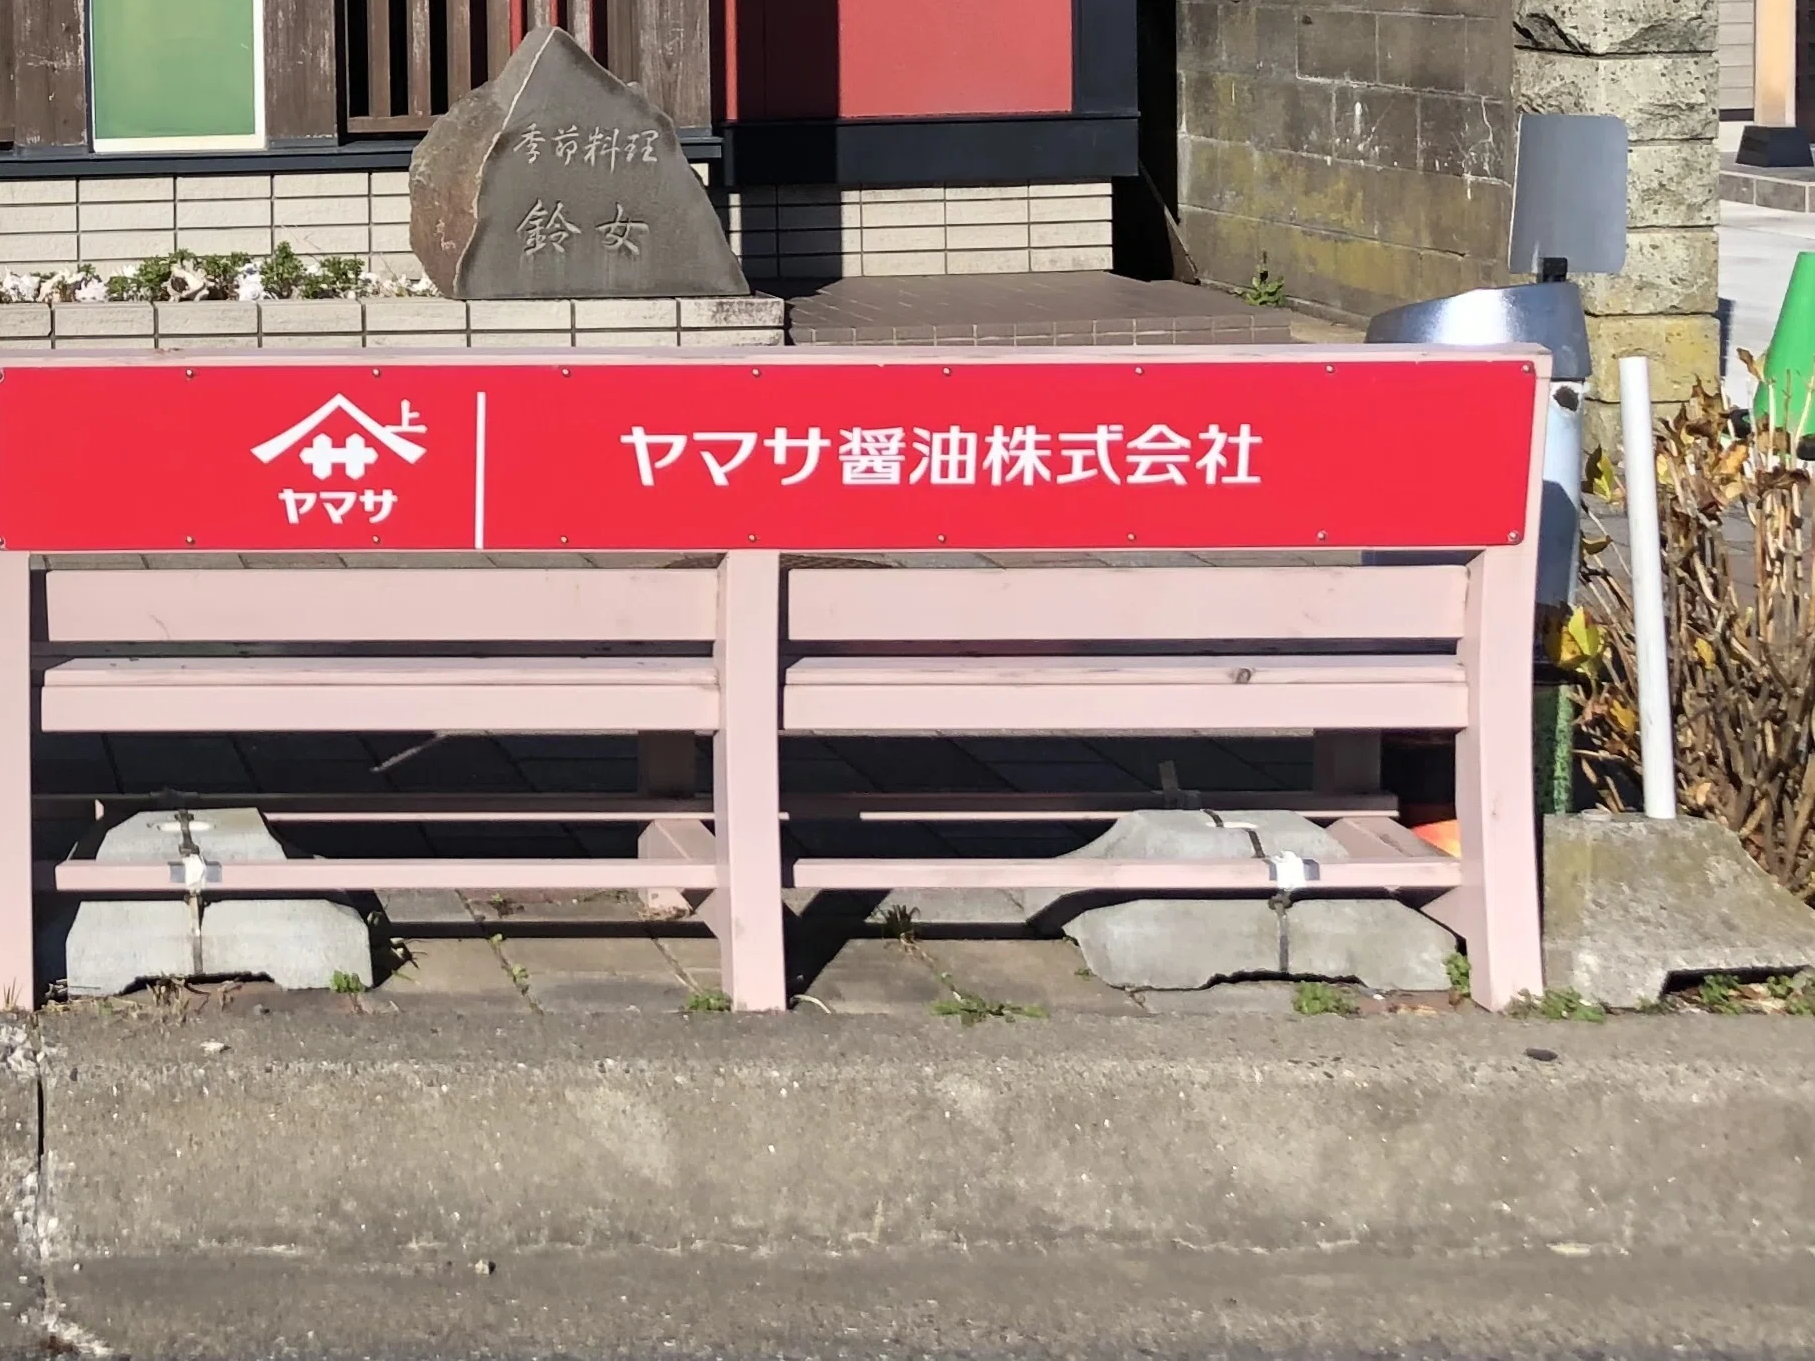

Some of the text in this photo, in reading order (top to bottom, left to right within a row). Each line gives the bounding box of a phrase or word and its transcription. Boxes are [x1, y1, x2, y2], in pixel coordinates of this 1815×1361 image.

[516, 199, 650, 255] 鈴女
[619, 423, 1263, 487] ヤマサ醤油株式会社
[277, 488, 399, 525] ヤマサ
